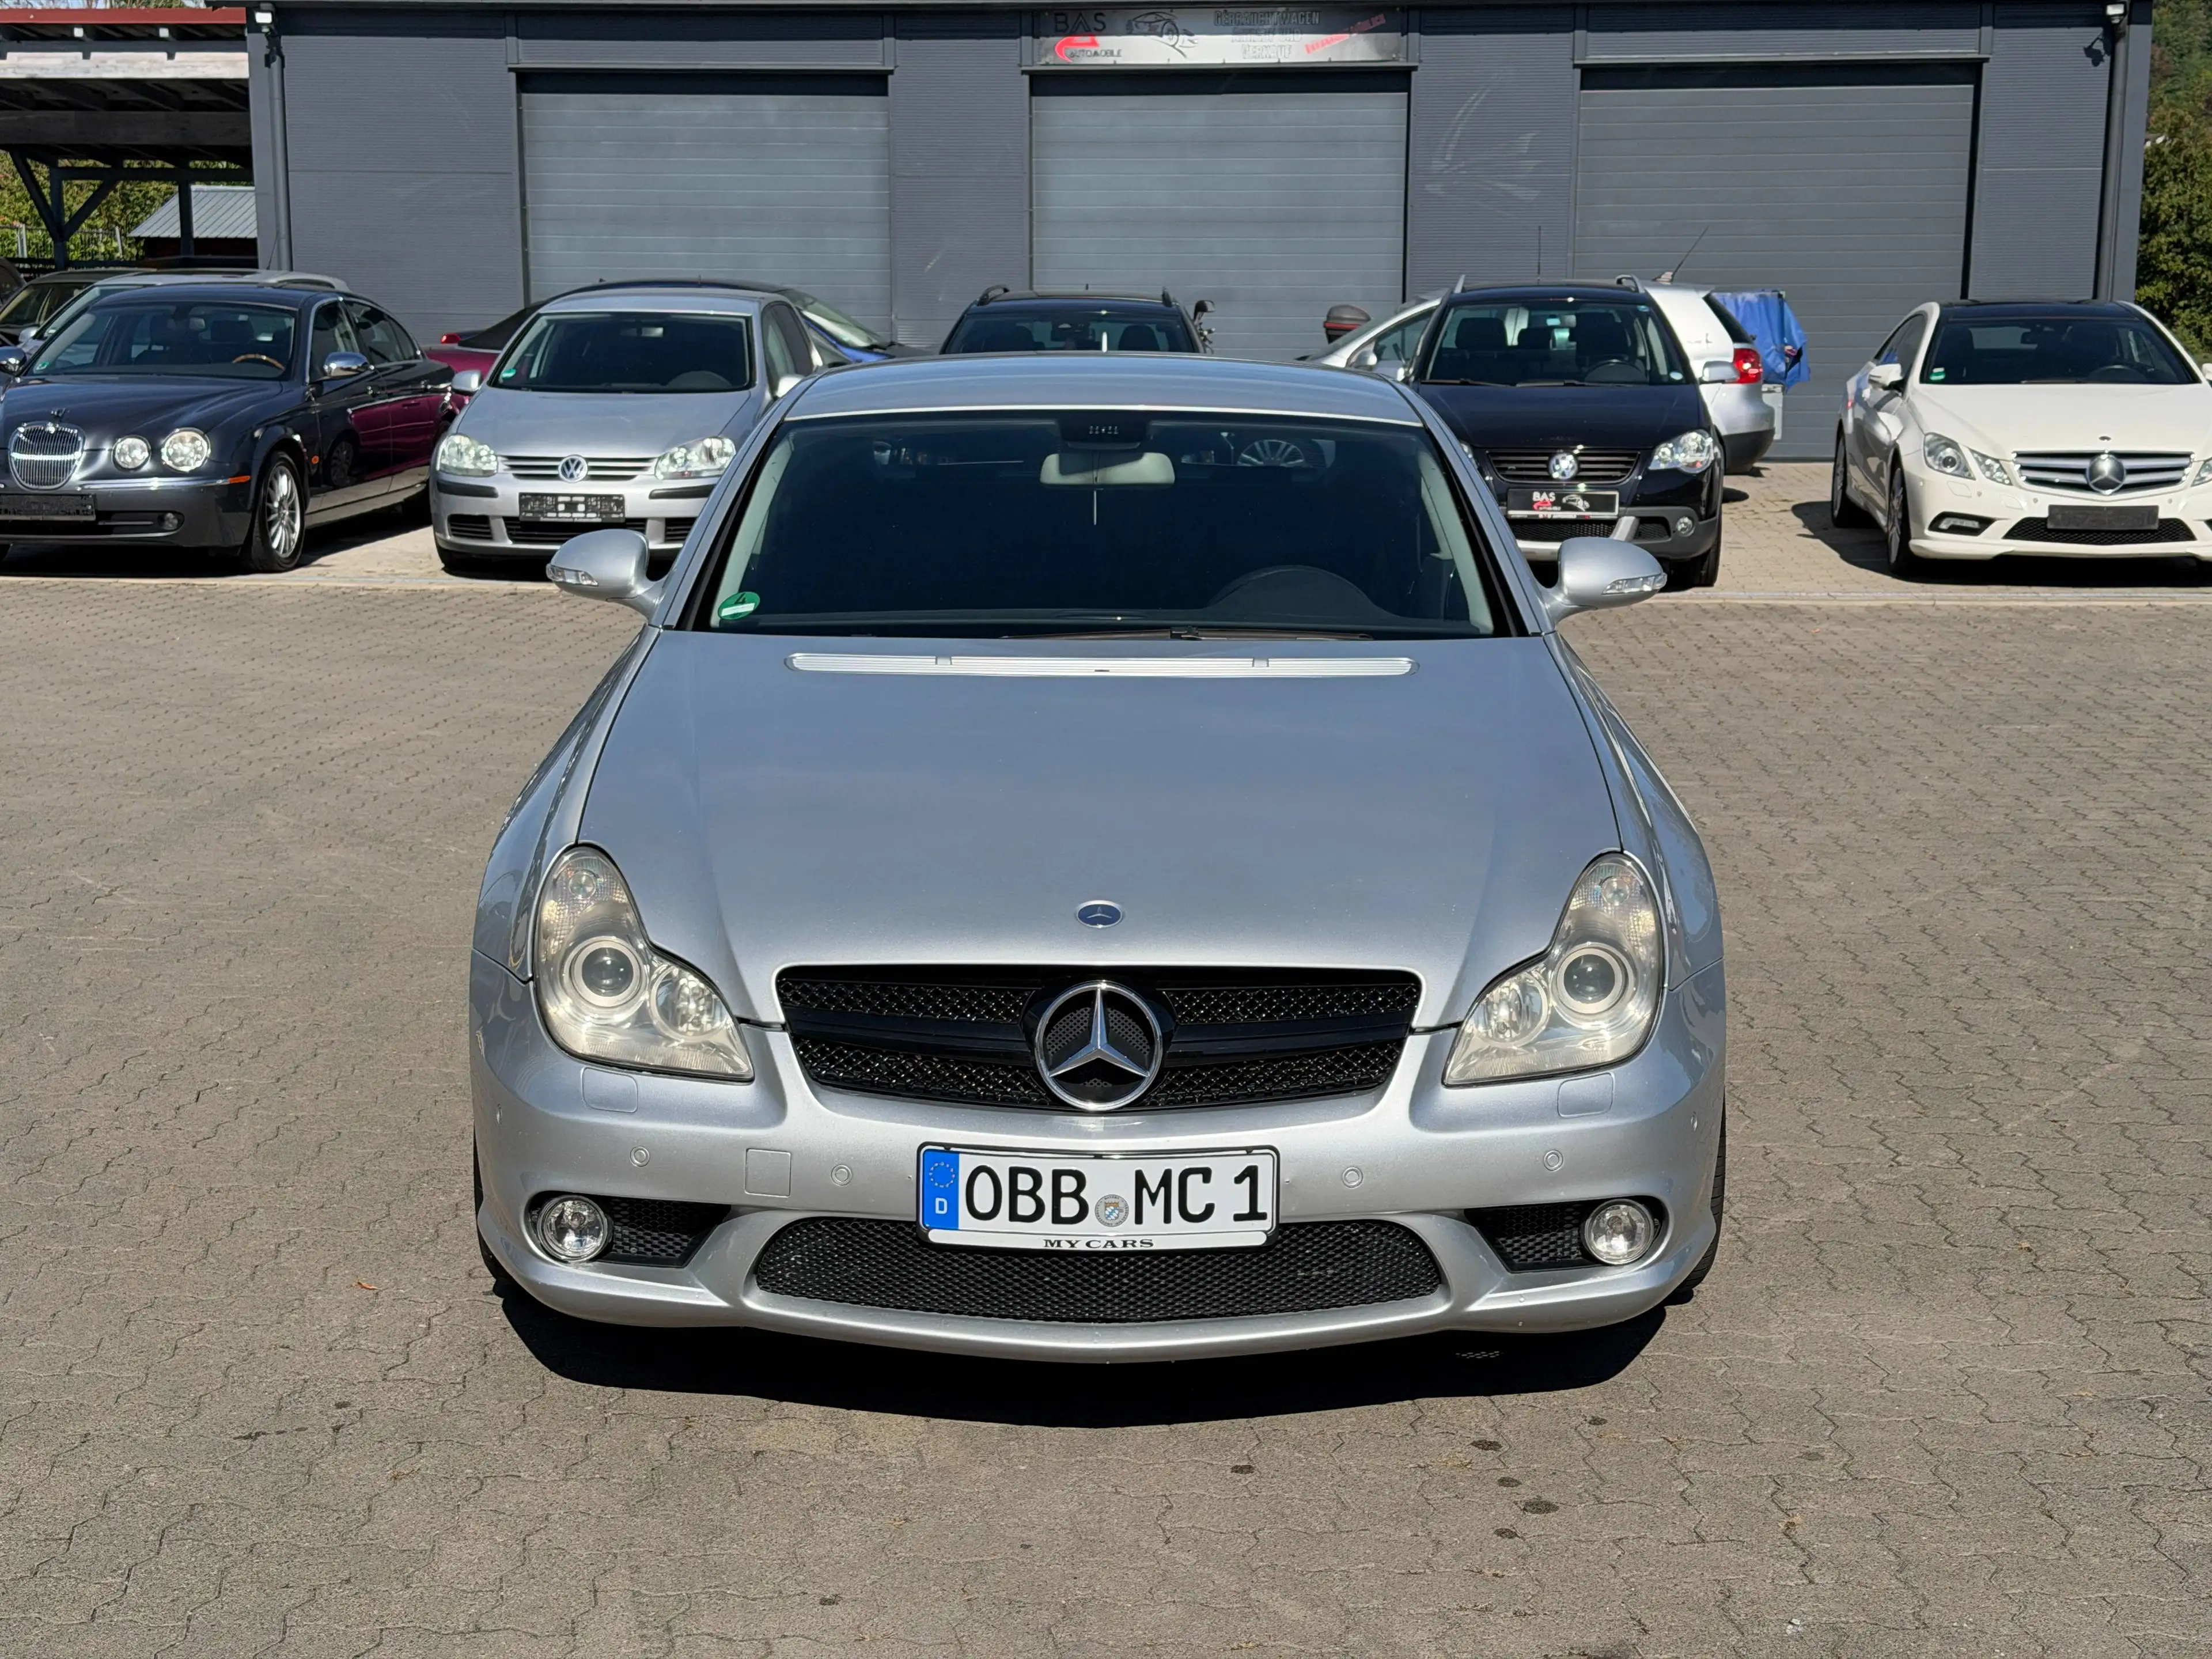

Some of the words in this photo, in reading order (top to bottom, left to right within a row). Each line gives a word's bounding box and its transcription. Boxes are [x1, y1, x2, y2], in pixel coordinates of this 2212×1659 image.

[1054, 12, 1106, 33] BAS
[1214, 10, 1320, 26] GEBRAUCHTWAGEN
[1532, 491, 1556, 502] BAS
[734, 593, 747, 605] 4
[965, 1165, 1089, 1225] OBB
[1134, 1166, 1215, 1225] MC
[1233, 1165, 1268, 1222] 1
[935, 1198, 948, 1215] D
[1043, 1238, 1081, 1249] MY
[1085, 1238, 1154, 1249] CARS
